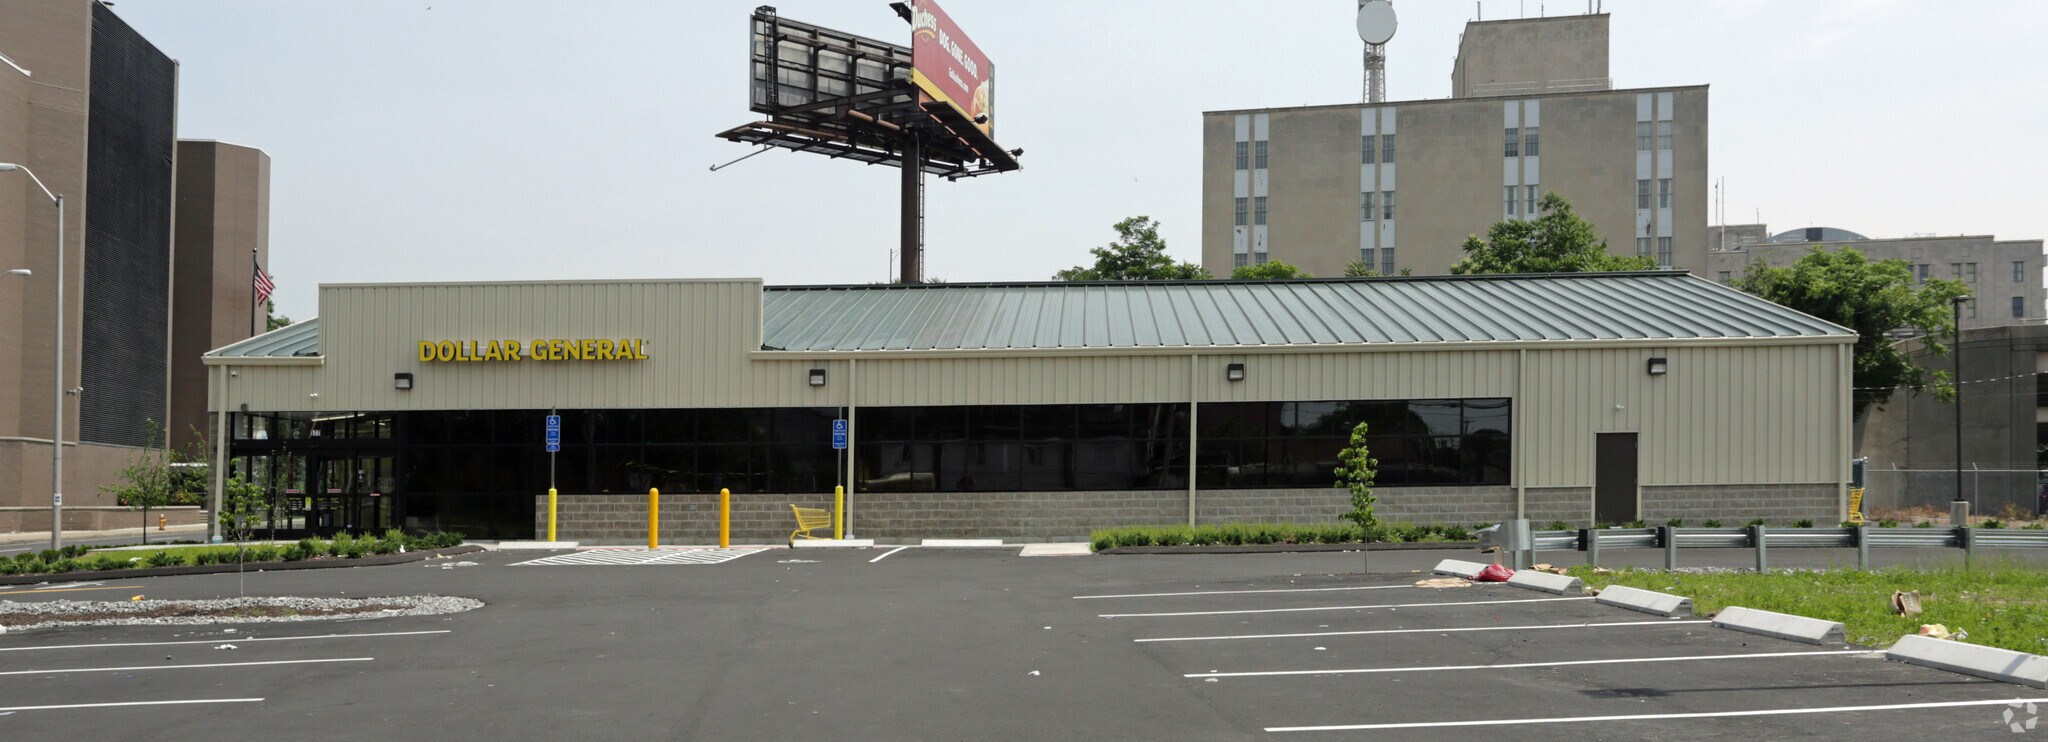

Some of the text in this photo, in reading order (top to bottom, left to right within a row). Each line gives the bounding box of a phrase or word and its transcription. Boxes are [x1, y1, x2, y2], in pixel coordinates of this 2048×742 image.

[912, 6, 937, 32] Duchess
[418, 338, 649, 362] DOLLAR GENERAL
